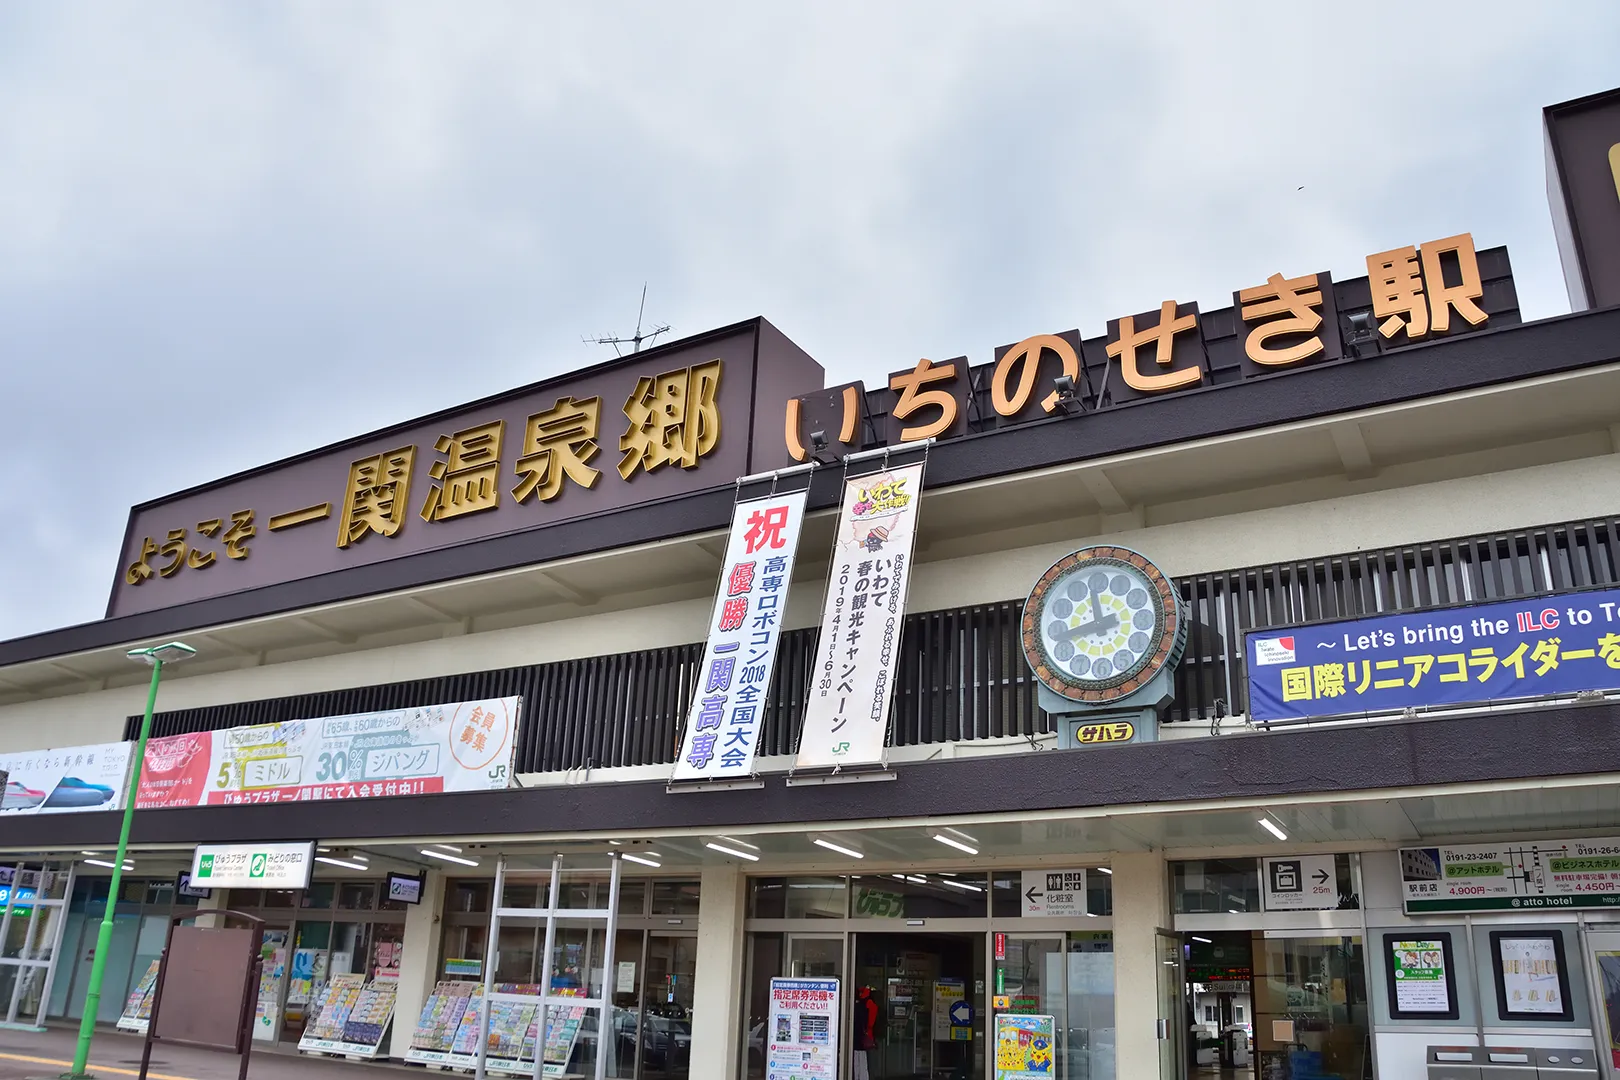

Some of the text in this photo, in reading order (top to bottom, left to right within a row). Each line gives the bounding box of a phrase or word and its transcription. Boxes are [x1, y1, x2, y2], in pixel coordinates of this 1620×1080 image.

[785, 232, 1489, 461] いちのせき駅
[743, 505, 789, 554] 祝
[871, 559, 891, 607] いわて
[1402, 623, 1465, 644] bring
[1471, 616, 1510, 637] the
[1516, 608, 1560, 634] ILC
[1567, 607, 1593, 626] to
[831, 559, 873, 733] 春の観光キャンペーン
[721, 555, 788, 768] 高専ロボコン2018全国大会
[1280, 632, 1620, 702] 国際リニアコライダーを
[467, 705, 497, 733] 会員
[460, 724, 488, 753] 募集
[1082, 724, 1129, 741] サハラ
[832, 742, 850, 753] JR
[371, 749, 430, 773] ジパング
[255, 762, 291, 781] ミドル
[489, 764, 506, 778] JR
[267, 853, 303, 864] みどりの窓口
[1446, 852, 1498, 861] 0191-23-2407
[1578, 847, 1620, 855] 0191-26-6
[1312, 886, 1331, 894] 25m
[1409, 883, 1438, 892] 駅前店
[1046, 893, 1074, 903] 化粧室
[1523, 898, 1543, 906] atto
[1546, 897, 1573, 906] hotel
[773, 989, 835, 1001] 指定席券売機を
